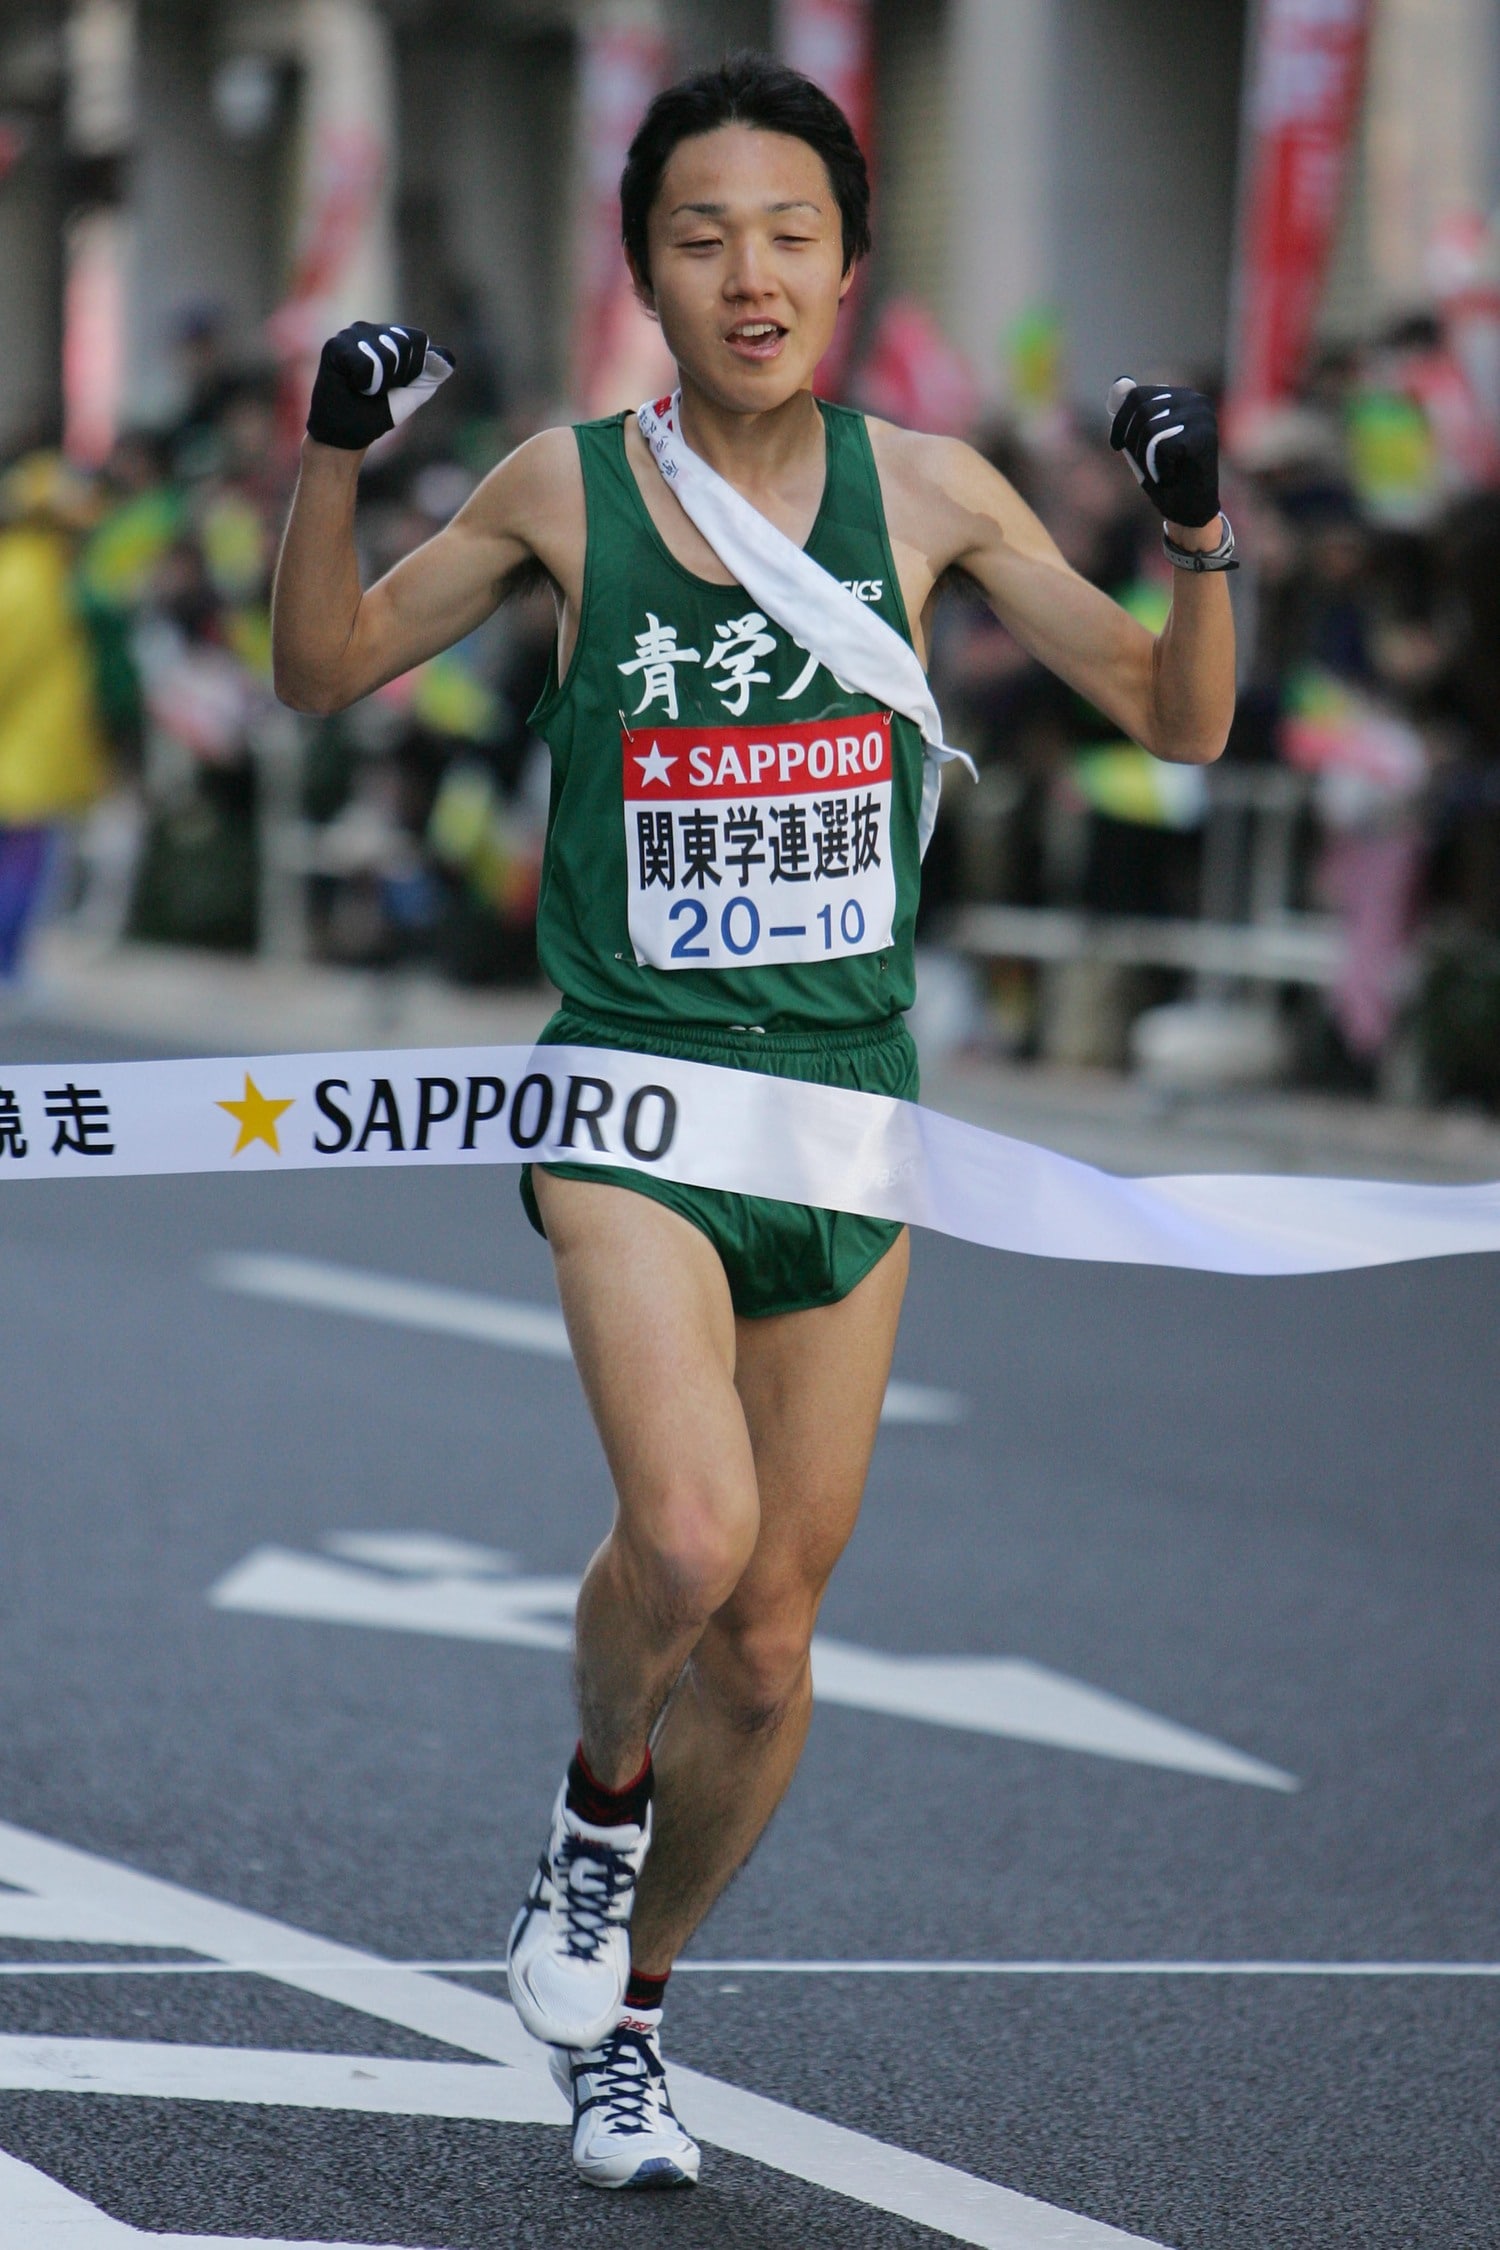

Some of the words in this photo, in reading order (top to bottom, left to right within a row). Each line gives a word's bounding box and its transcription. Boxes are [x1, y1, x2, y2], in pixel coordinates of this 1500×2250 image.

[688, 731, 884, 787] SAPPORO
[637, 792, 882, 891] 関東学連選抜
[314, 1073, 678, 1161] SAPPORO
